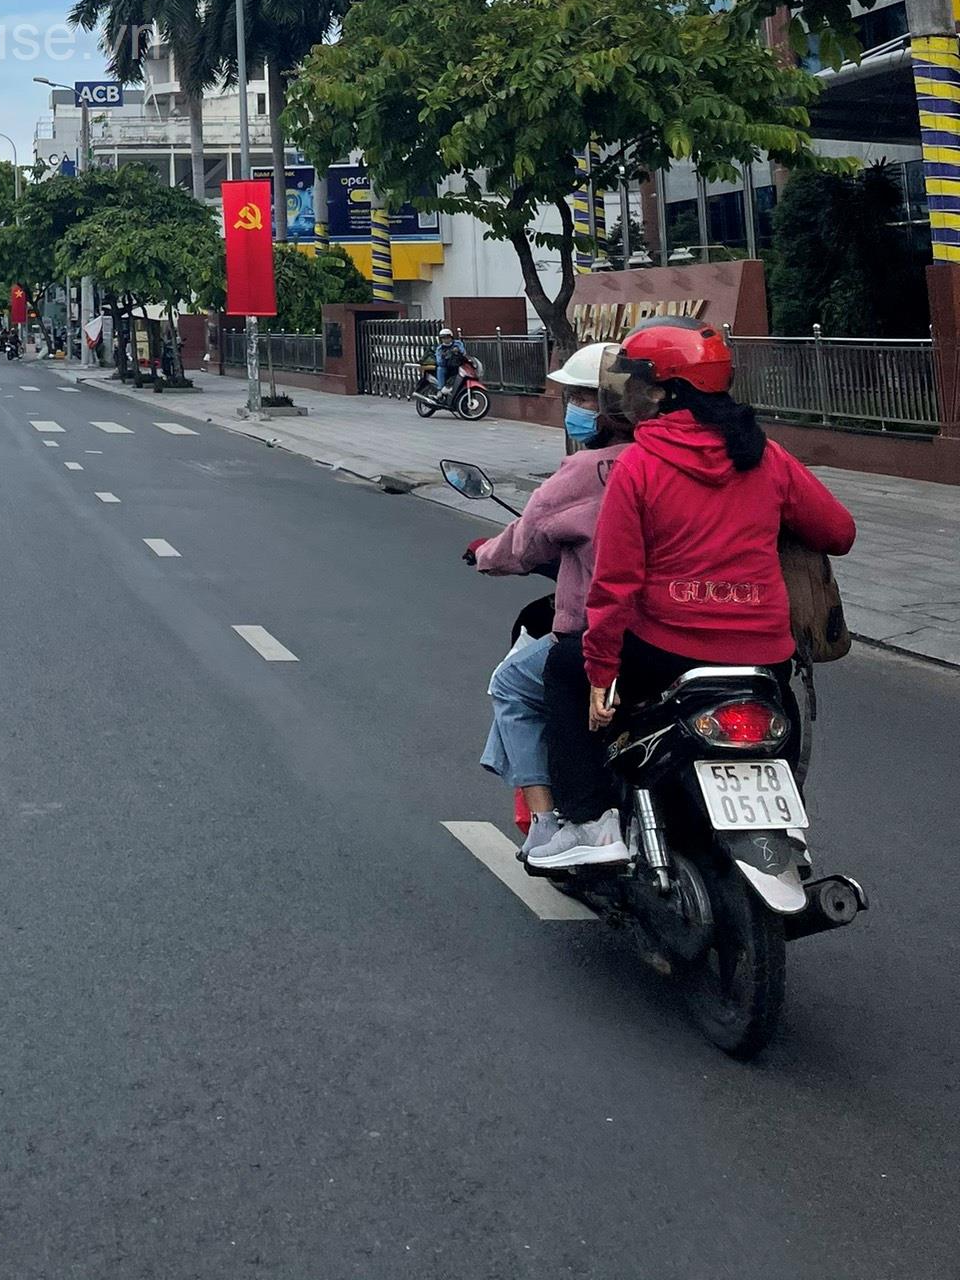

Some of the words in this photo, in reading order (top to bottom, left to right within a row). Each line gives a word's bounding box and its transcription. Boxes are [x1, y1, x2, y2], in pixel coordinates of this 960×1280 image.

[78, 85, 121, 103] ACB
[668, 580, 761, 606] GUCCI
[710, 765, 782, 793] 55-Z8
[721, 795, 792, 824] 0519
